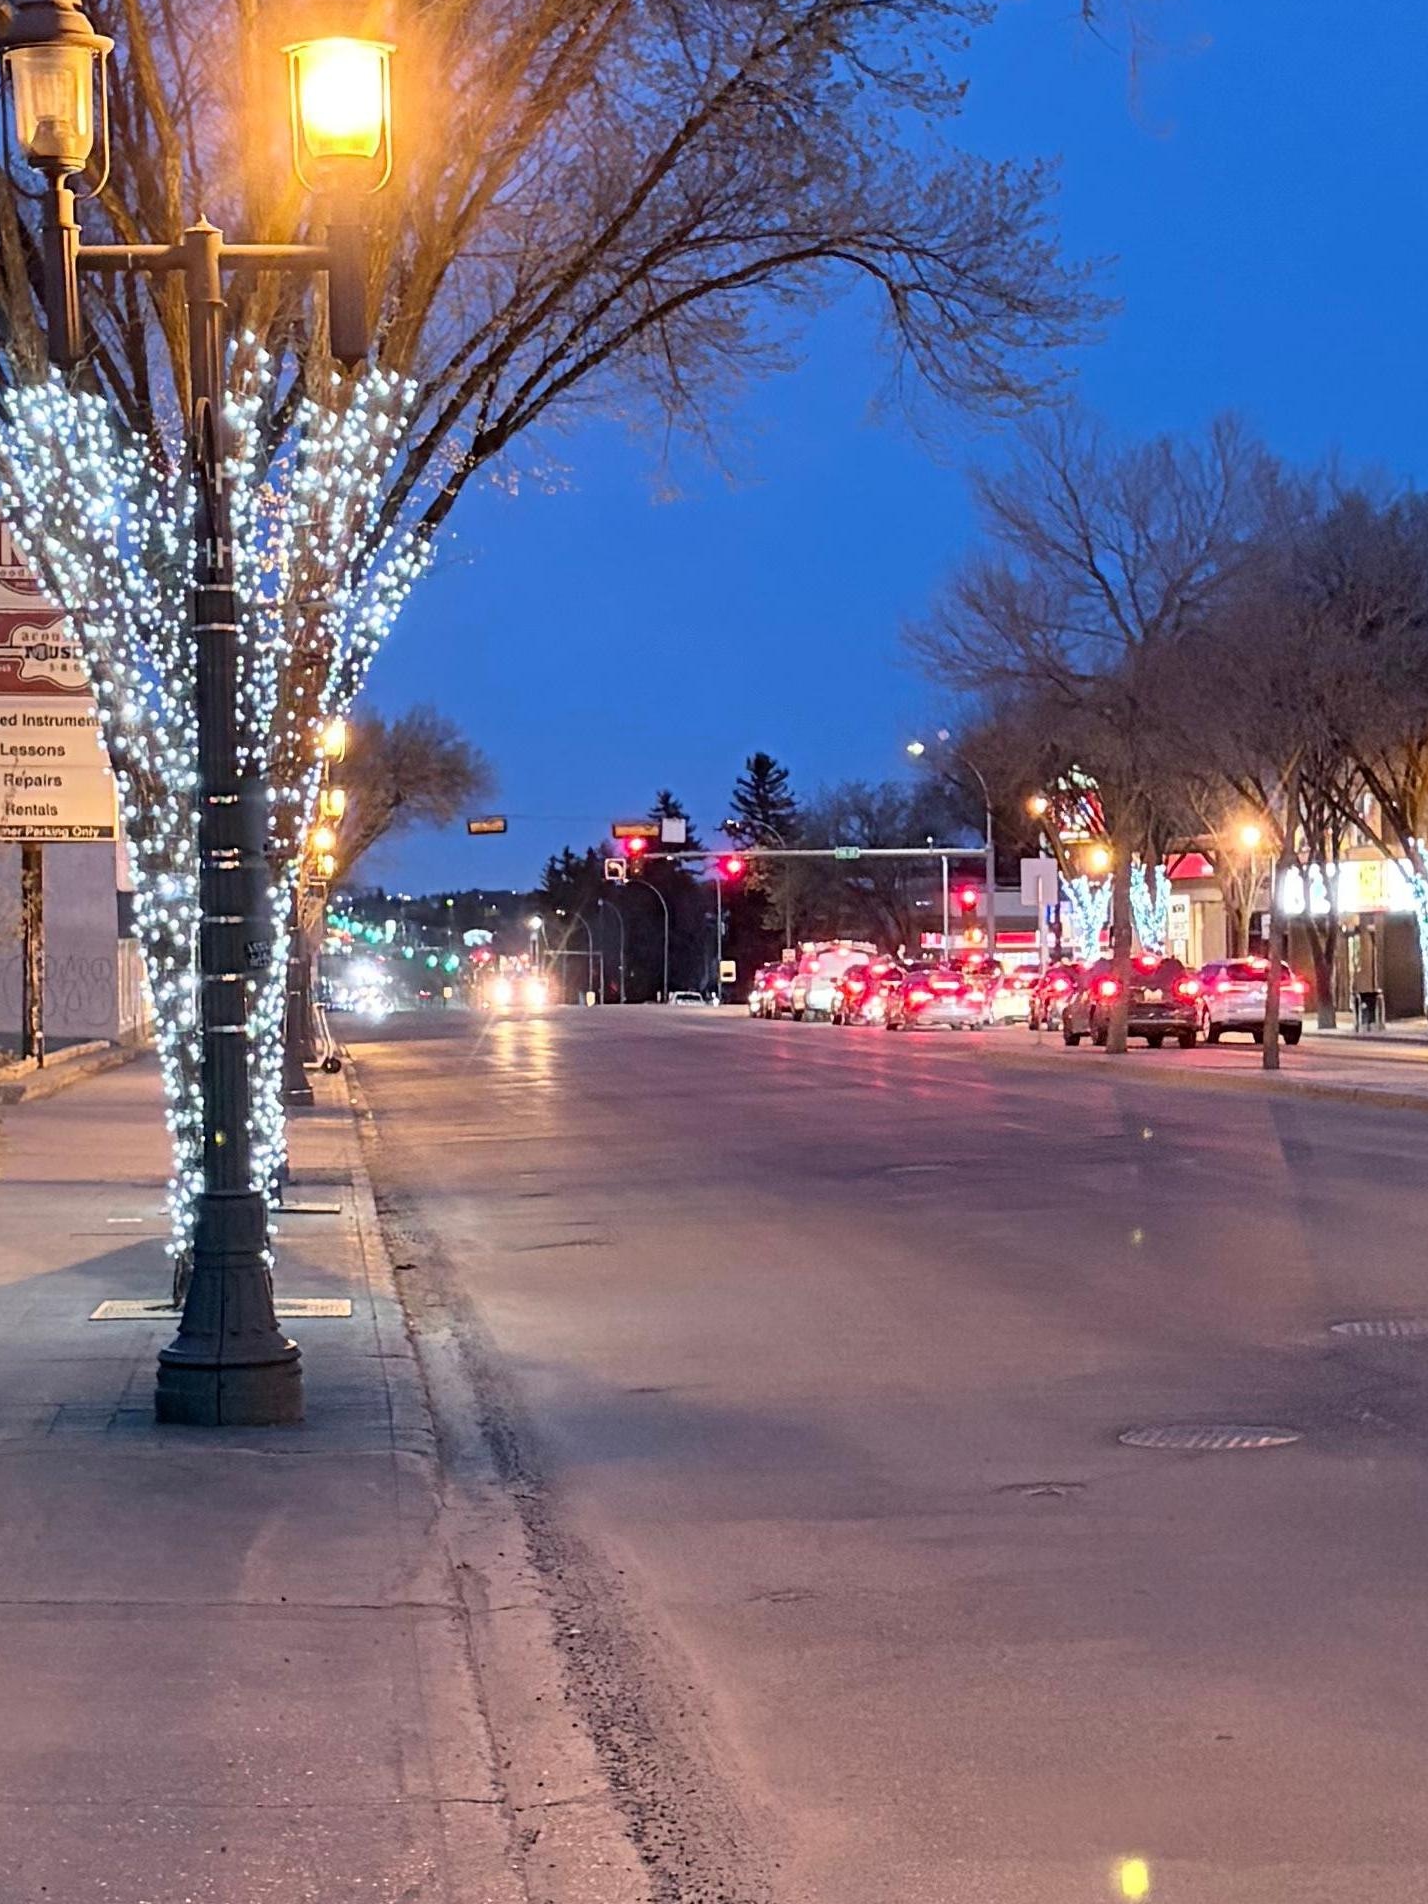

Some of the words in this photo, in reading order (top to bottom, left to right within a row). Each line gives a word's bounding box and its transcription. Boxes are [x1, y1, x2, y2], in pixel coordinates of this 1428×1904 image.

[25, 646, 81, 659] MUSI
[22, 713, 100, 727] Instrument
[0, 743, 66, 757] Lessons
[4, 773, 62, 789] Repairs
[5, 803, 58, 816] Rentals
[25, 826, 69, 838] Parking
[72, 826, 99, 838] Only
